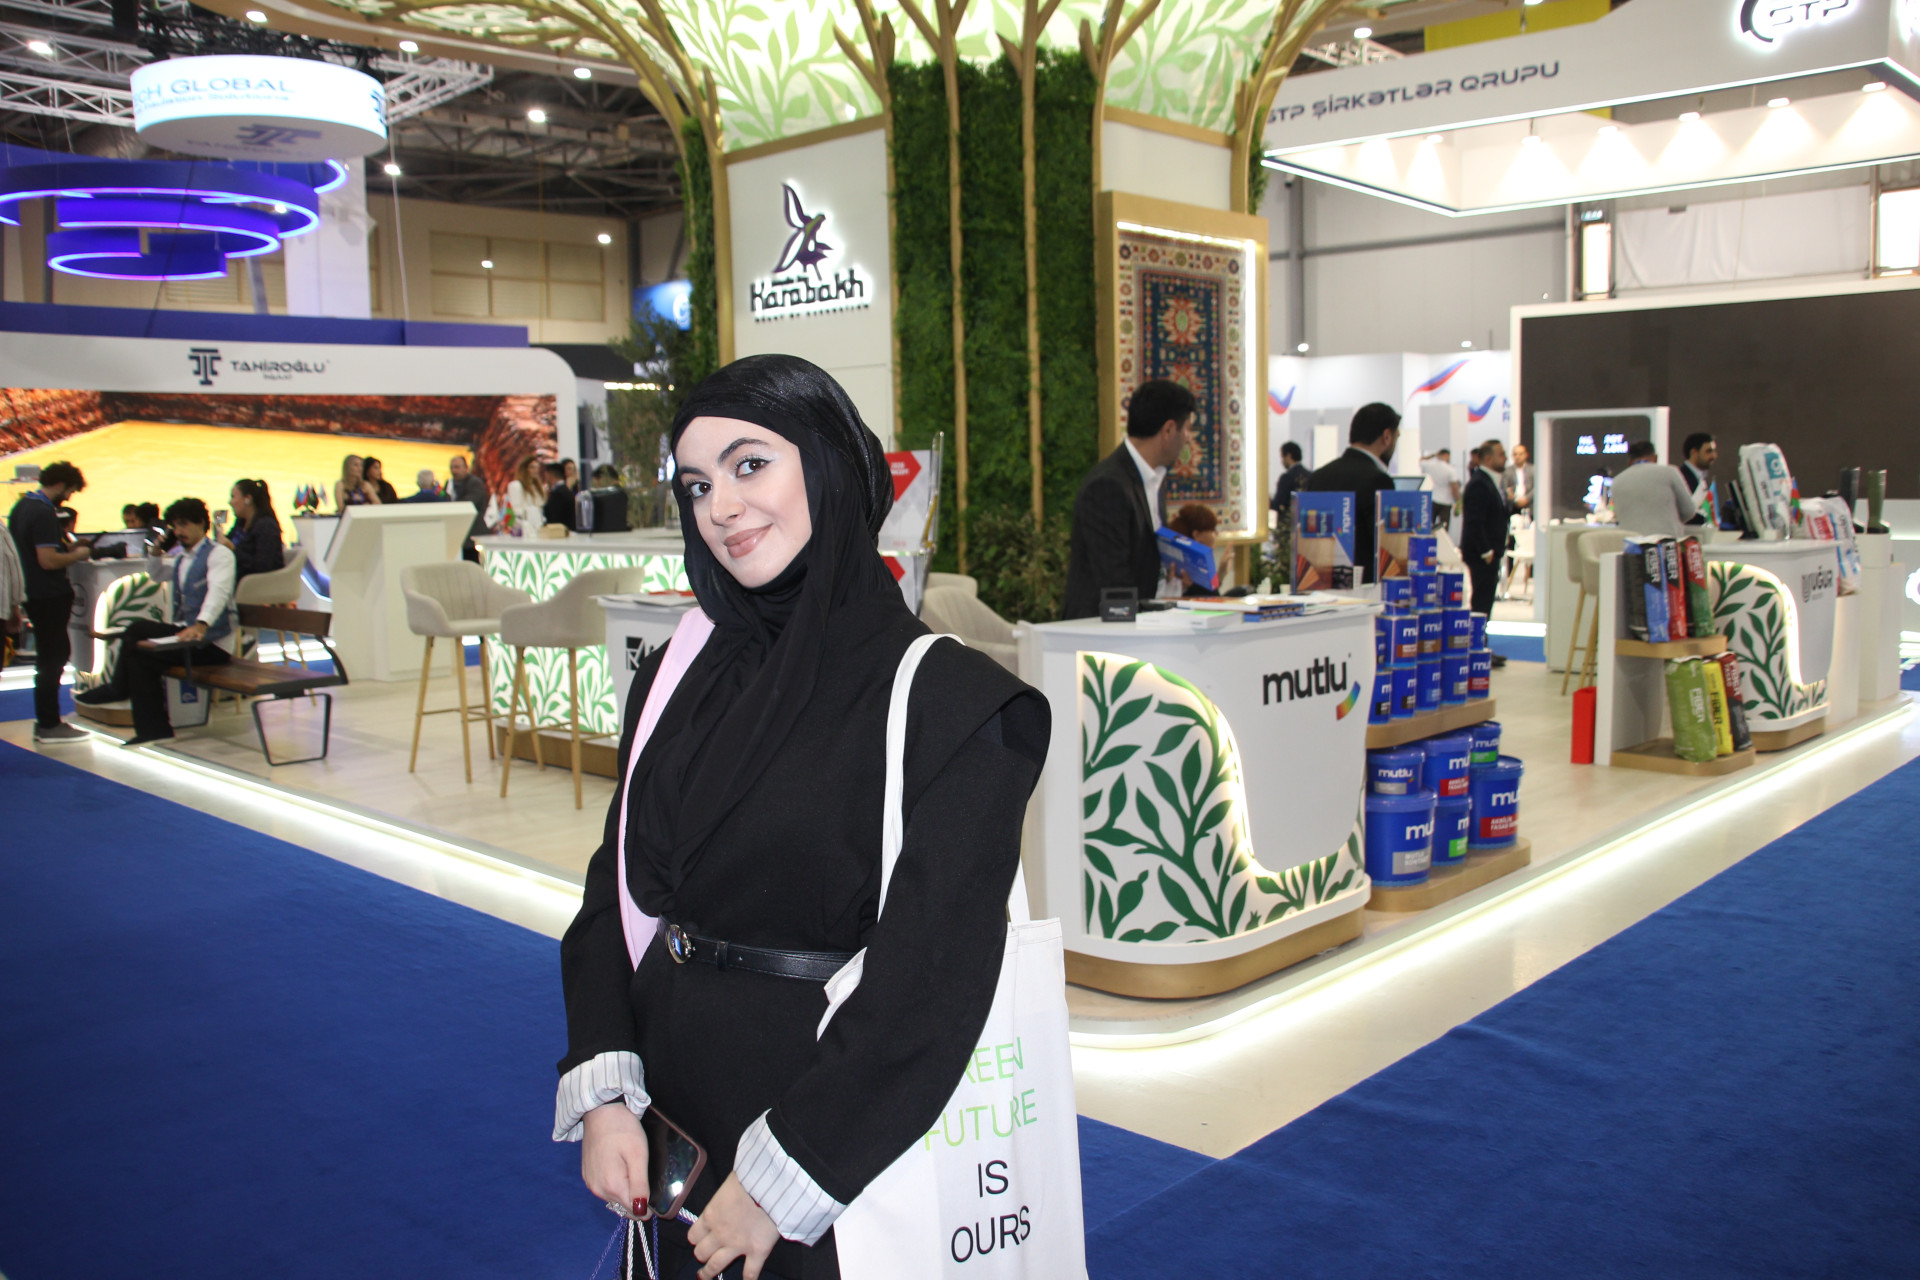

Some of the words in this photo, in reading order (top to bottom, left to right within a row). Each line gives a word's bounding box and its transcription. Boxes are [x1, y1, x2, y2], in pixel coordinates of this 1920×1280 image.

[170, 78, 296, 95] GLOBAL
[1460, 61, 1560, 92] QRUPU
[1263, 656, 1347, 706] mutlu
[1378, 768, 1413, 778] mutlu
[978, 1160, 1009, 1198] IS
[951, 1205, 1031, 1263] OURS
